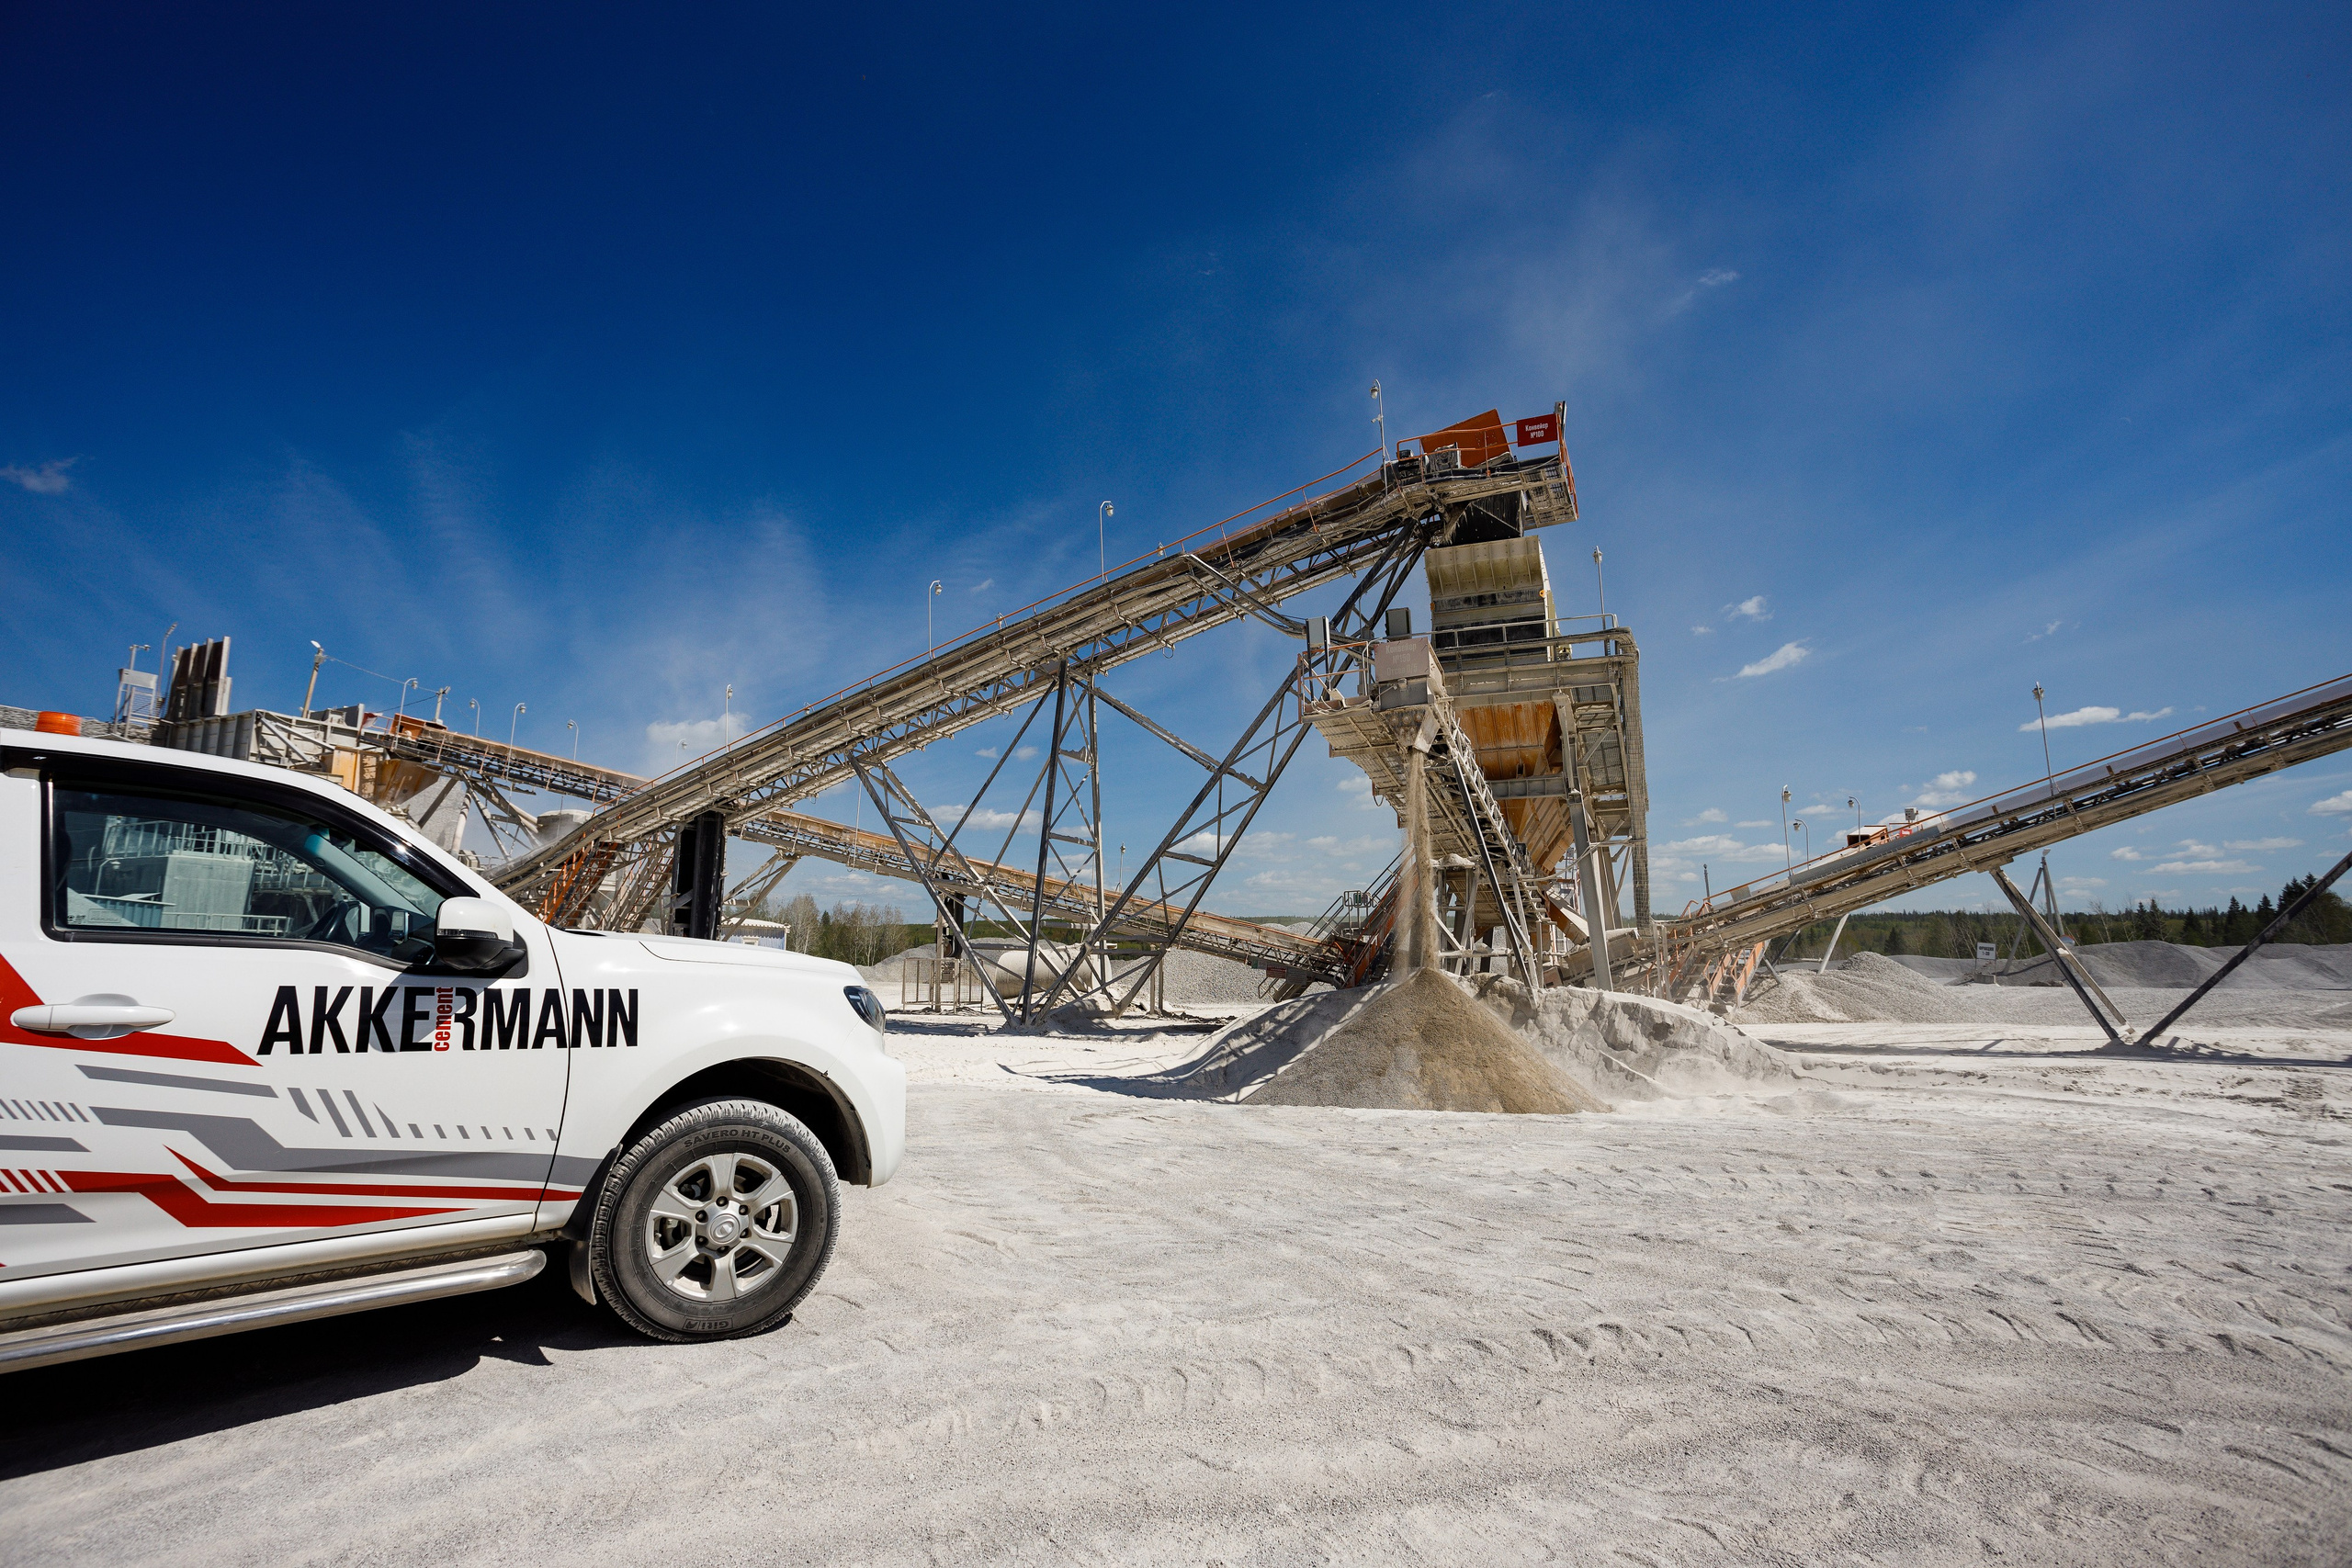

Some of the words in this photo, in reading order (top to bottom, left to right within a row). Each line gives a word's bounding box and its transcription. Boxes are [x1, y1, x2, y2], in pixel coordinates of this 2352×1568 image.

[1525, 423, 1548, 431] Конвейер
[1531, 430, 1544, 438] №100
[1385, 643, 1417, 654] Конвейер
[256, 986, 639, 1055] AKKERMANN
[434, 987, 454, 1052] cement
[684, 1129, 739, 1148] SAVERO
[741, 1129, 760, 1139] HT
[762, 1134, 791, 1153] PLUS
